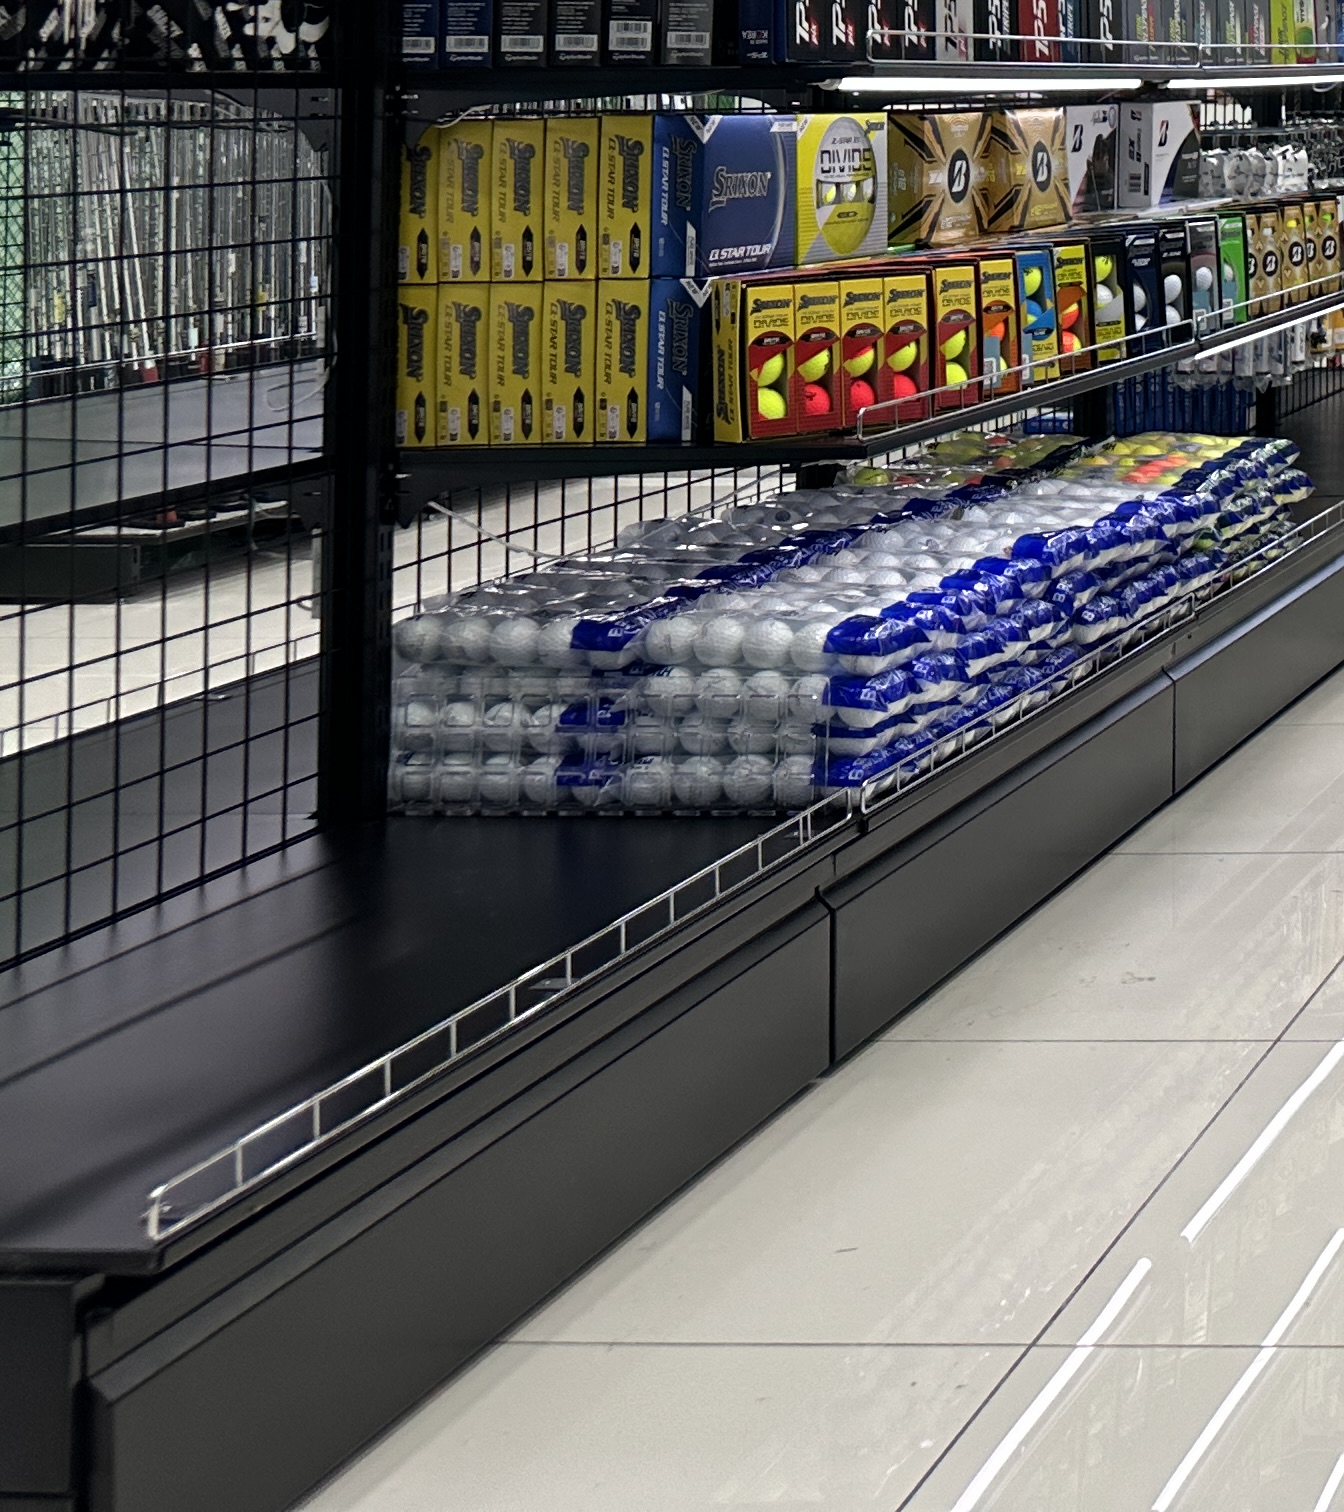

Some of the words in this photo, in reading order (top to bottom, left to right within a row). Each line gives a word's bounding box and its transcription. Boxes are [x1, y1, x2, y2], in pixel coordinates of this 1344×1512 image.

[615, 134, 645, 212] SRIXON
[660, 192, 669, 226] TOUR
[671, 134, 698, 212] SRIXON
[709, 166, 771, 213] SRIXON
[720, 246, 746, 259] STAR
[745, 243, 772, 257] TOUR
[557, 299, 587, 378] SRIXON
[612, 299, 641, 378] SRIXON
[656, 356, 665, 389] TOUR
[666, 298, 693, 376] SRIXON
